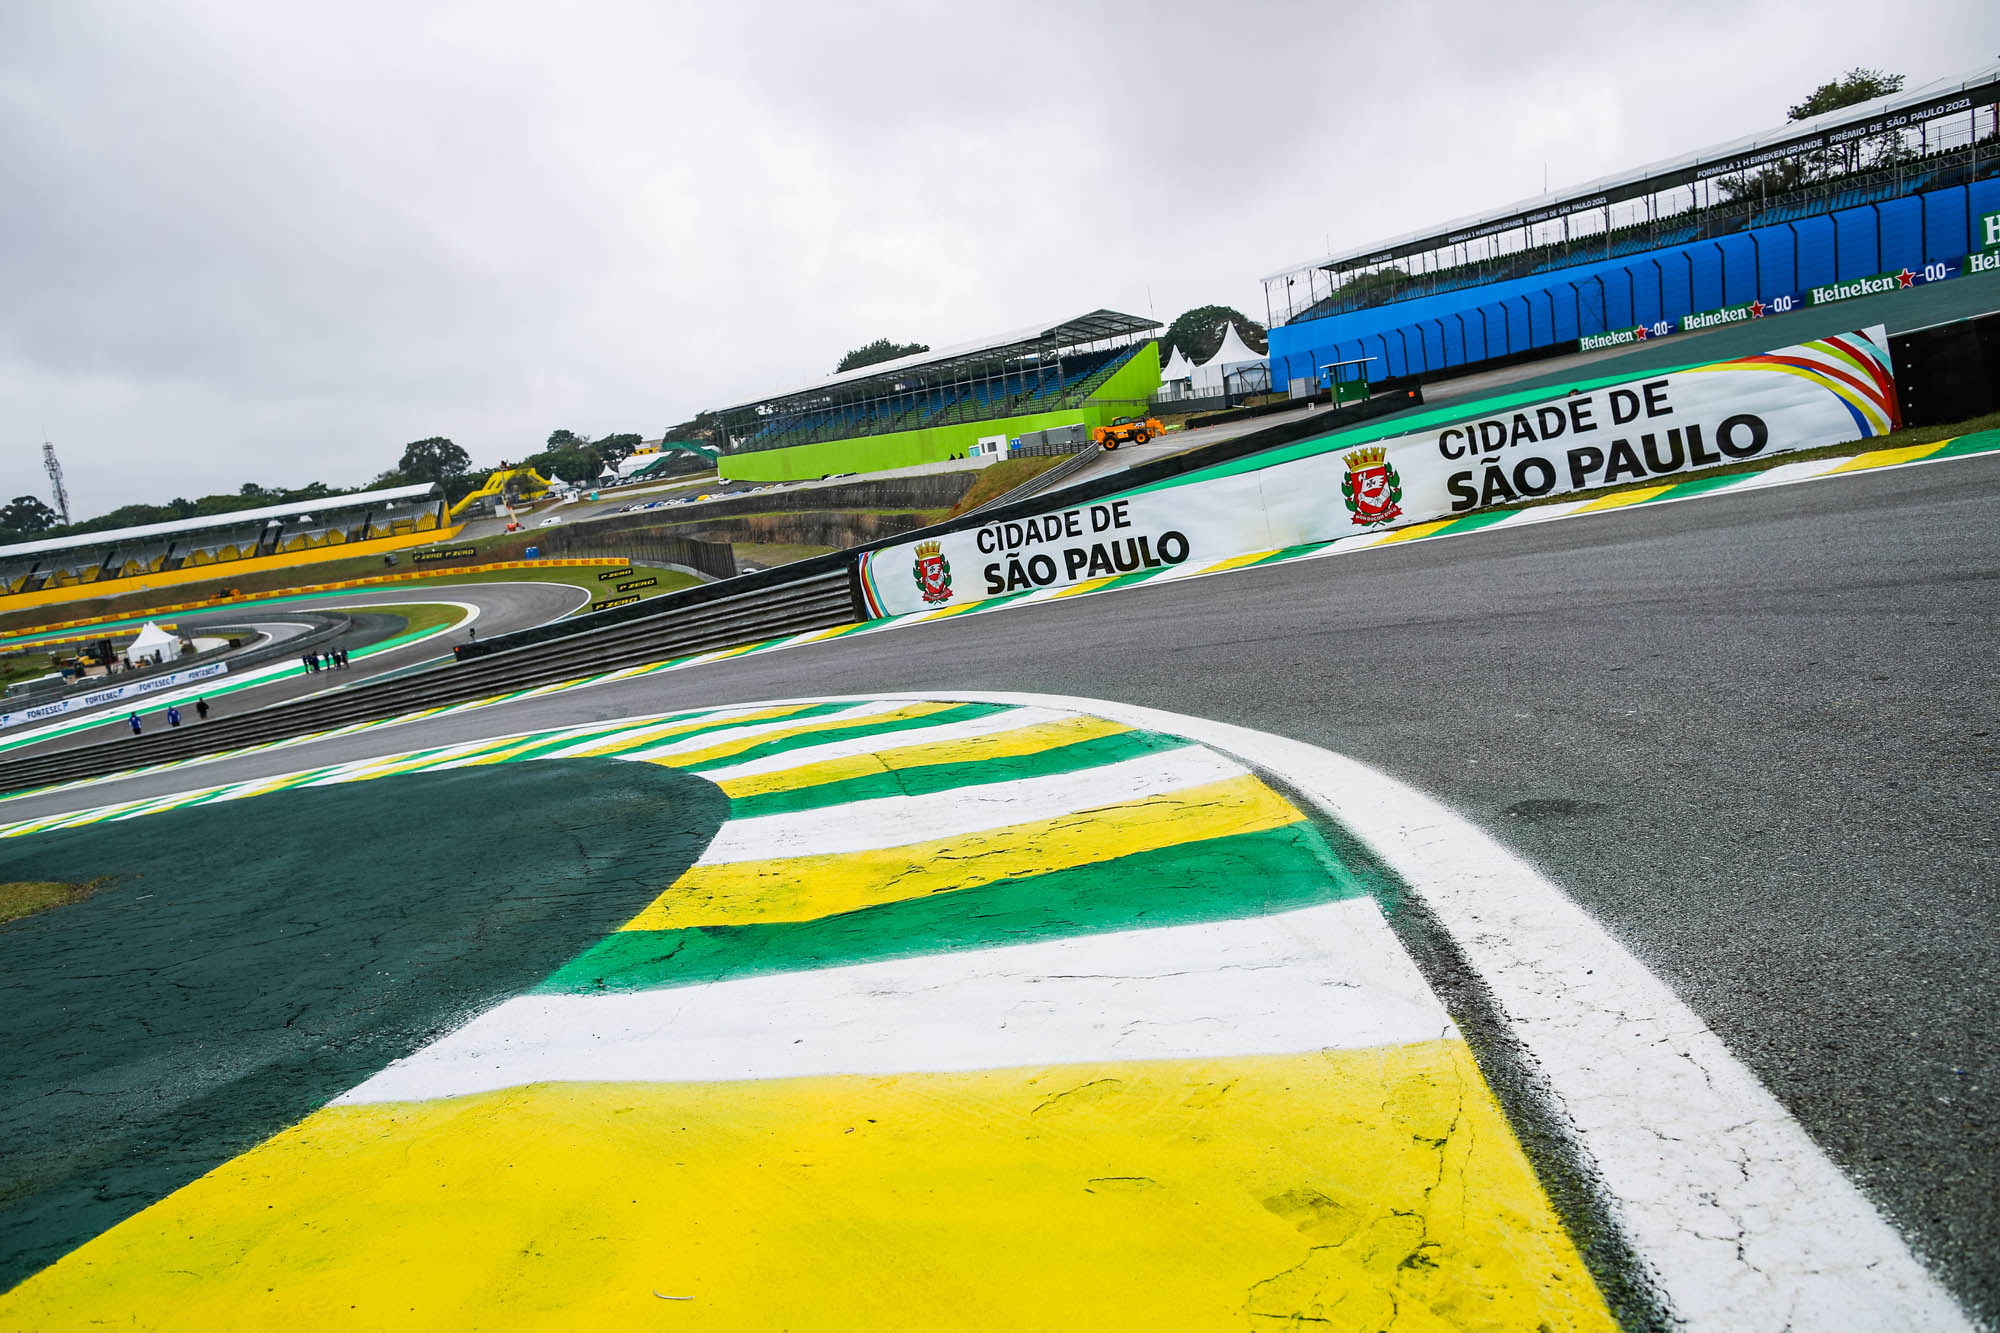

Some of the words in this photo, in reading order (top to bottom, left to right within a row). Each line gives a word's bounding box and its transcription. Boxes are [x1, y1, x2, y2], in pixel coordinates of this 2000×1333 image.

[1696, 162, 1735, 178] FORMULA
[1786, 138, 1823, 154] GRANDE
[1869, 122, 1883, 133] DE
[1886, 115, 1907, 128] SÃO
[1910, 105, 1945, 122] PAULO
[1945, 98, 1971, 112] 2021
[1812, 278, 1895, 304] Heineken
[1580, 331, 1634, 351] Heineken
[1683, 308, 1748, 330] Heineken
[1439, 397, 1597, 460] CIDADE
[1608, 379, 1674, 425] DE
[1446, 456, 1557, 512] SÃO
[1567, 413, 1769, 489] PAULO
[976, 510, 1083, 554] CIDADE
[1090, 500, 1131, 533] DE
[983, 552, 1058, 595] SÃO
[1064, 531, 1190, 580] PAULO
[27, 704, 63, 720] FORTESEC
